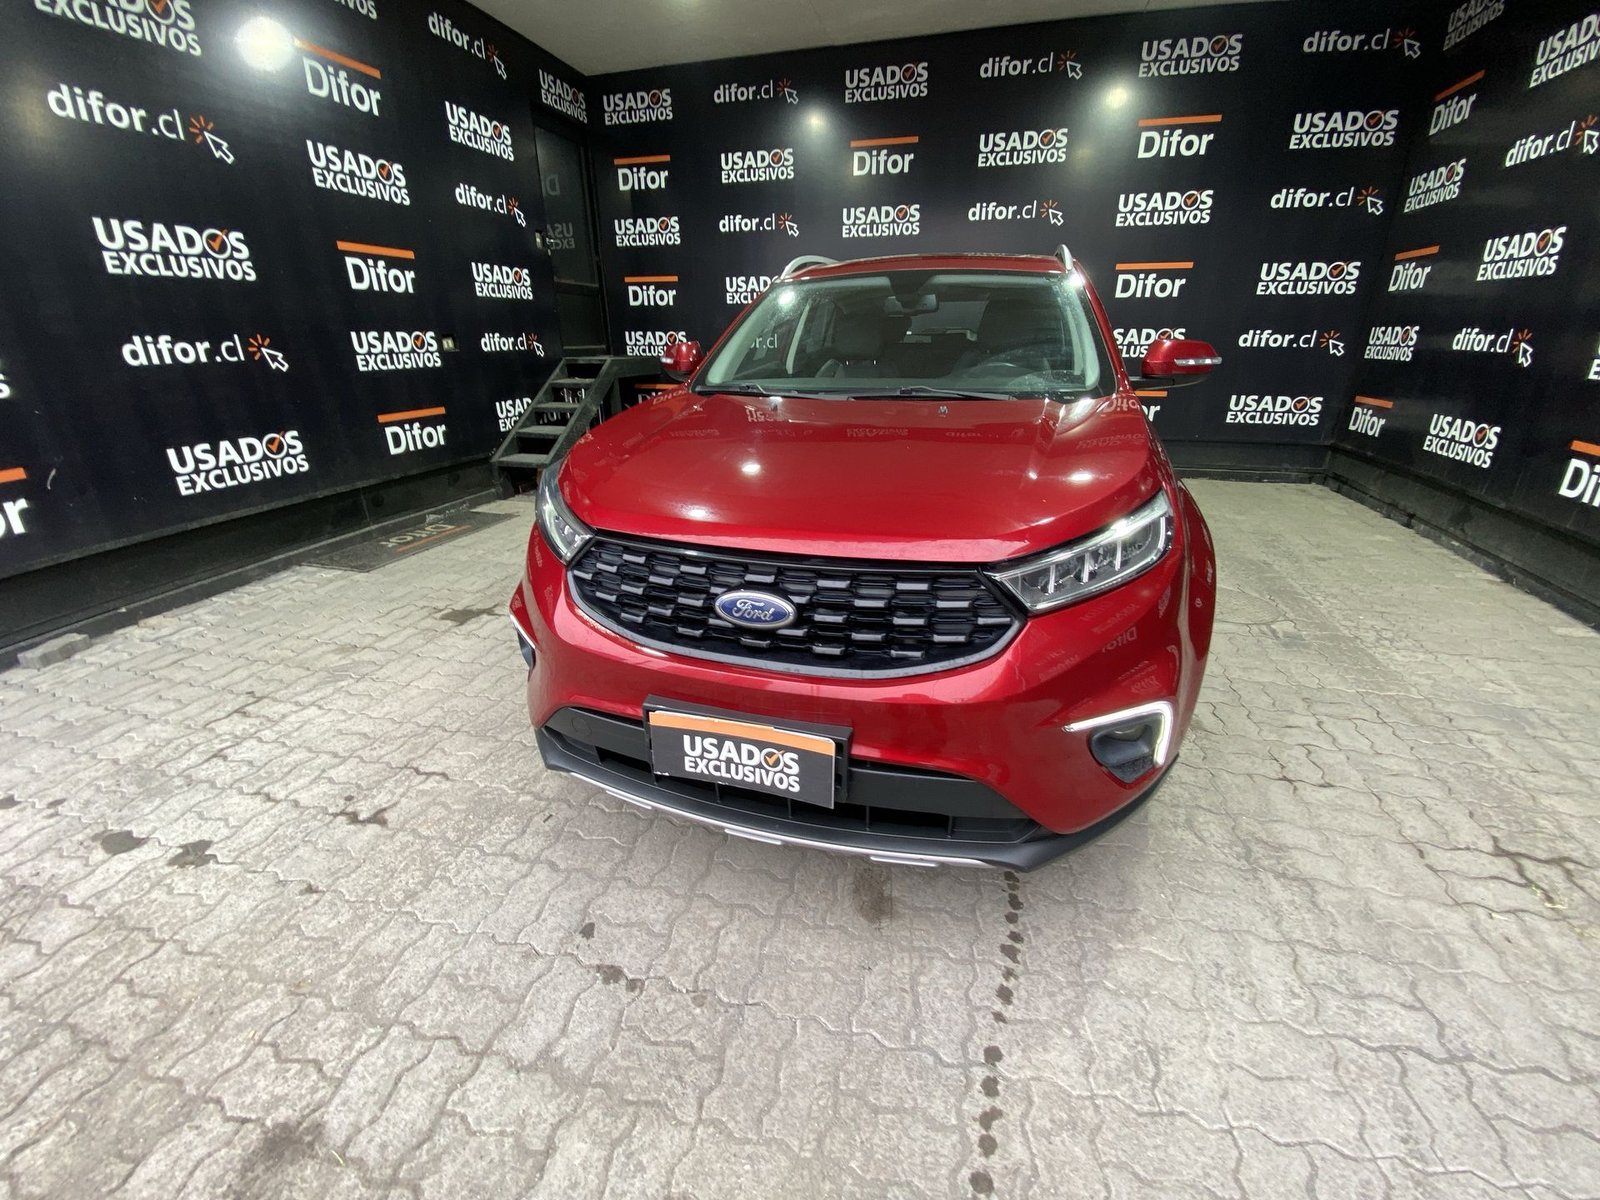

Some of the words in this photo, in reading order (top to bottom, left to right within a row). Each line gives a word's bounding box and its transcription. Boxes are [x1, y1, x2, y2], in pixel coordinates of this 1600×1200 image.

[428, 12, 486, 60] difor.cl
[1141, 33, 1243, 61] USADOS
[1303, 28, 1390, 53] difor.cl
[1536, 14, 1600, 66] USAD
[845, 62, 928, 88] USADOS
[979, 52, 1054, 78] difor.cl
[1138, 55, 1240, 78] EXCLUSIVOS
[1529, 39, 1600, 89] EXCLUSIV
[302, 56, 381, 117] Difor
[539, 69, 586, 108] USADOS
[713, 79, 774, 104] difor.cl
[844, 82, 928, 103] EXCLUSIVOS
[47, 83, 186, 141] difor.cl
[541, 90, 588, 124] EXCLUSIVOS
[603, 88, 672, 112] USADOS
[445, 101, 512, 146] USADOS
[604, 107, 673, 126] EXCLUSIVOS
[1293, 109, 1399, 133] USADOS
[1428, 93, 1477, 136] Difor
[449, 124, 515, 162] EXCLUSIVOS
[979, 128, 1068, 152] USADOS
[1137, 129, 1214, 159] Difor
[1289, 129, 1395, 149] EXCLUSIVOS
[1505, 120, 1576, 168] difor.cl
[306, 139, 407, 187] USADOS
[720, 148, 794, 170] USADOS
[852, 150, 914, 176] Difor
[977, 148, 1067, 167] EXCLUSIVOS
[312, 167, 411, 206] EXCLUSIVOS
[617, 167, 669, 191] Difor
[721, 166, 795, 184] EXCLUSIVOS
[1409, 158, 1467, 195] USADOS
[455, 182, 507, 215] difor.cl
[1118, 190, 1214, 212] USADOS
[1270, 187, 1354, 209] difor.cl
[1404, 182, 1461, 213] EXCLUSIVOS
[719, 213, 776, 233] difor.cl
[842, 204, 920, 225] USADOS
[968, 200, 1037, 221] difor.cl
[1115, 209, 1211, 227] EXCLUSIVOS
[614, 216, 680, 234] USADOS
[842, 220, 920, 238] EXCLUSIVOS
[92, 216, 250, 260] USADOS
[616, 232, 681, 247] EXCLUSIVOS
[1483, 226, 1567, 262] USADOS
[102, 250, 257, 281] EXCLUSIVOS
[344, 256, 415, 293] Difor
[471, 262, 531, 286] USADOS
[1260, 261, 1361, 281] USADOS
[1388, 261, 1431, 292] Difor
[1477, 255, 1558, 281] EXCLUSIVOS
[475, 282, 534, 300] EXCLUSIVOS
[628, 285, 677, 306] Difor
[725, 276, 777, 292] USAD
[1114, 273, 1186, 298] Difor
[1256, 280, 1357, 295] EXCLUSIVOS
[350, 330, 438, 354] USADOS
[480, 332, 527, 352] difor.cl
[1113, 328, 1186, 345] SADOS
[1238, 329, 1317, 349] difor.cl
[1368, 325, 1420, 346] USADOS
[1452, 327, 1514, 353] difor.cl
[121, 333, 246, 367] difor.cl
[356, 352, 442, 372] EXCLUSIVOS
[626, 345, 667, 357] EXCLUS
[1364, 345, 1414, 362] EXCLUSIVOS
[496, 397, 532, 419] USAD
[1229, 394, 1323, 413] USADOS
[1225, 411, 1320, 427] EXCLUSIVOS
[1348, 406, 1386, 438] Difor
[1429, 413, 1501, 450] USADOS
[384, 422, 446, 455] Difor
[166, 431, 303, 474] USADOS
[1423, 435, 1494, 469] EXCLUSIVOS
[175, 454, 310, 496] EXCLUSIVOS
[732, 599, 776, 621] Ford
[683, 735, 800, 775] USADOS
[684, 756, 800, 793] EXCLUSIVOS
